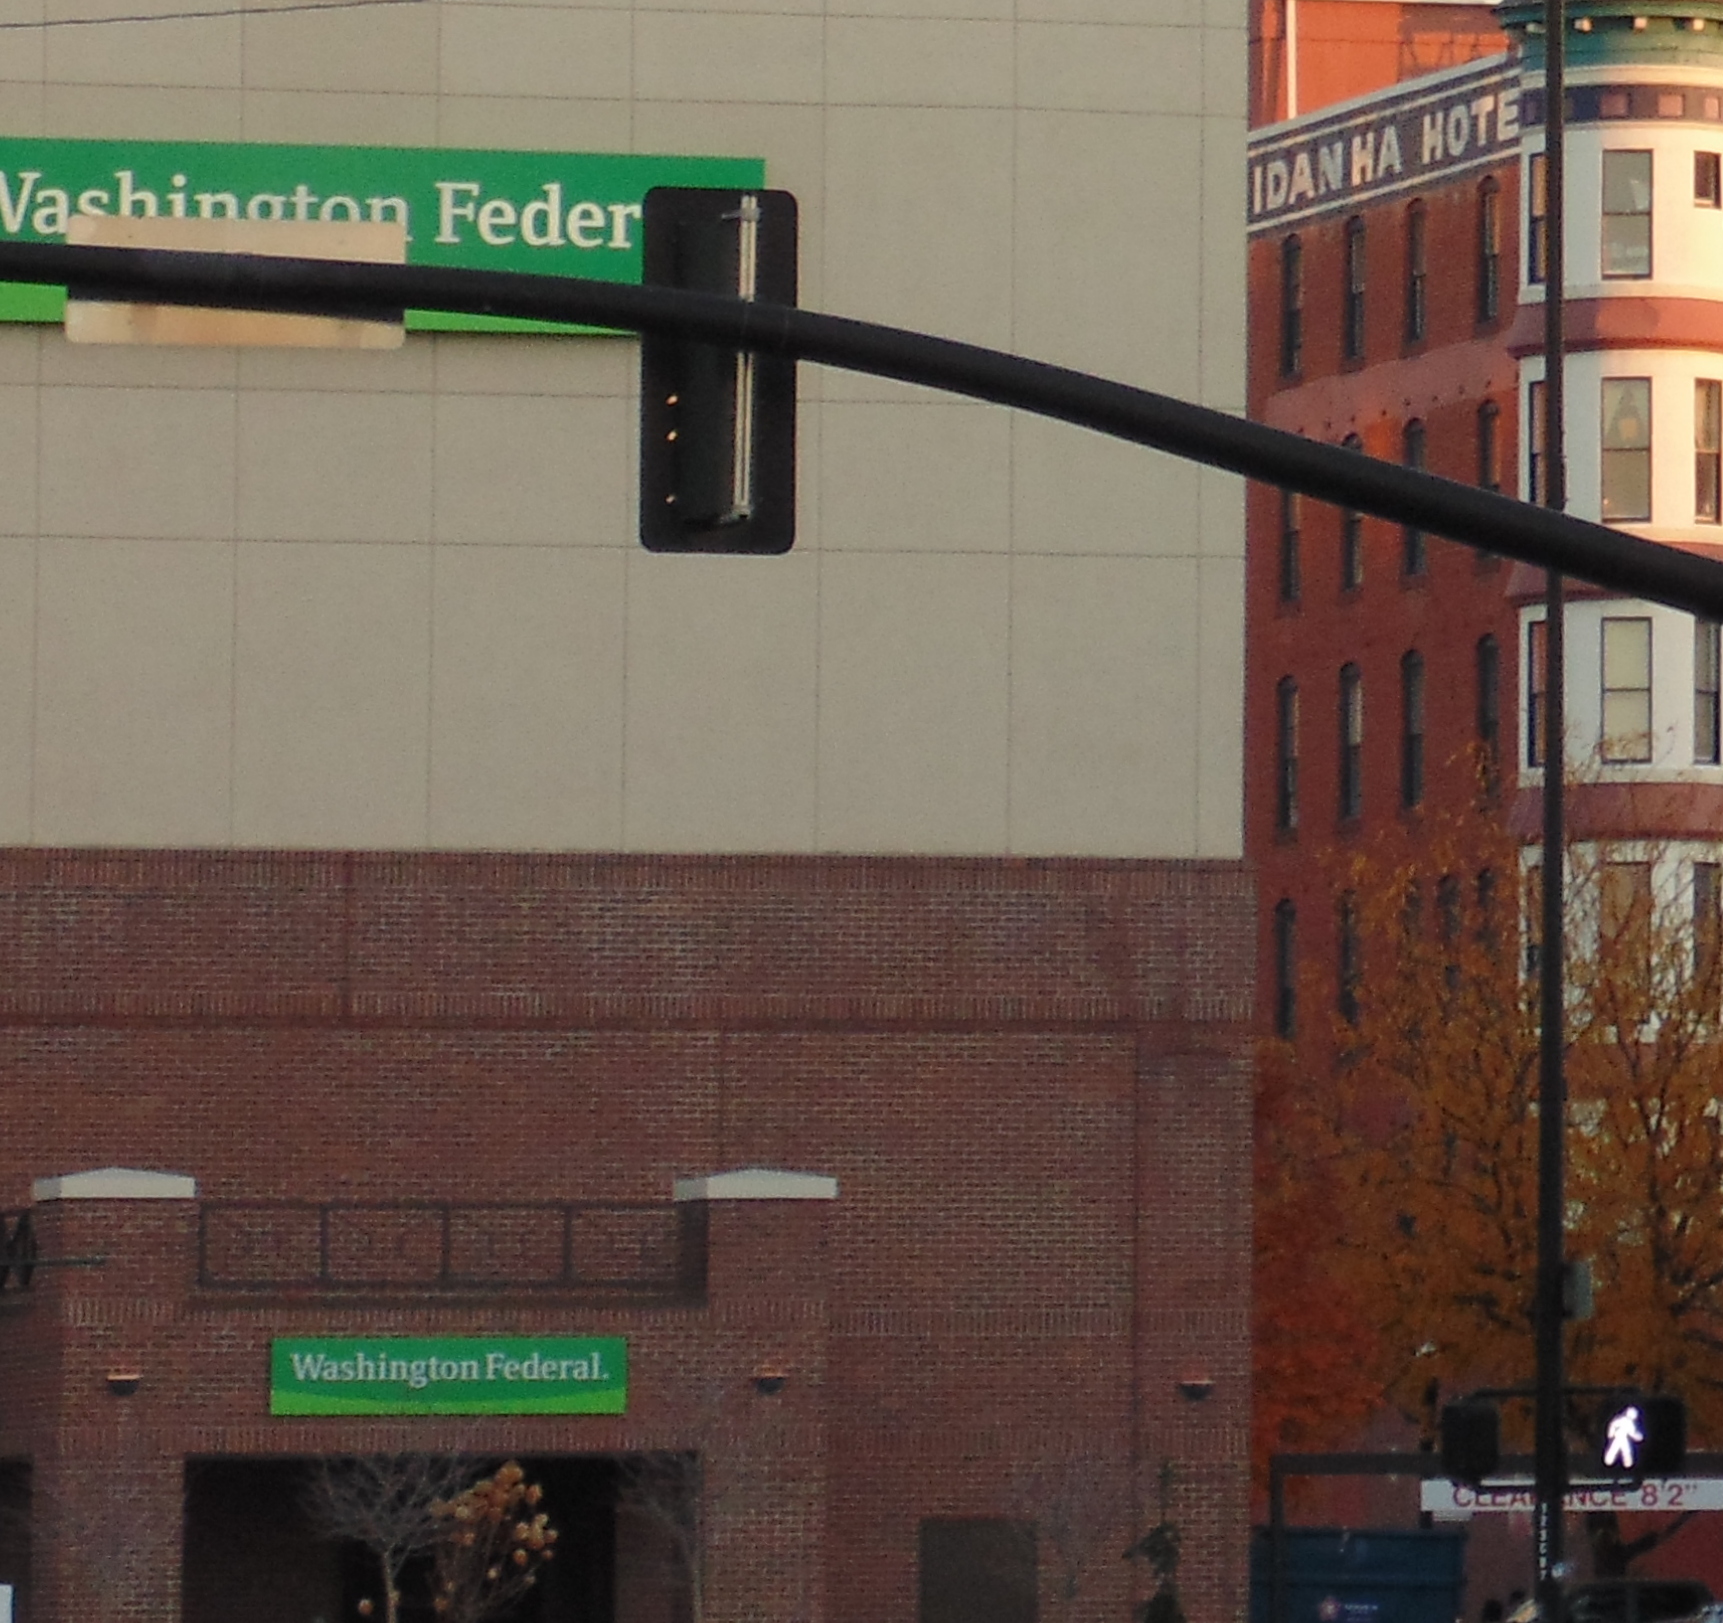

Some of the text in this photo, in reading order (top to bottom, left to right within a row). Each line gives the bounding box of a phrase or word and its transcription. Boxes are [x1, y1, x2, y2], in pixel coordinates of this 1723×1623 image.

[1252, 88, 1520, 214] IDANHA HOTE
[434, 181, 643, 249] Feder
[290, 1352, 609, 1389] Washington Federal.
[1452, 1485, 1627, 1507] CLEANCE
